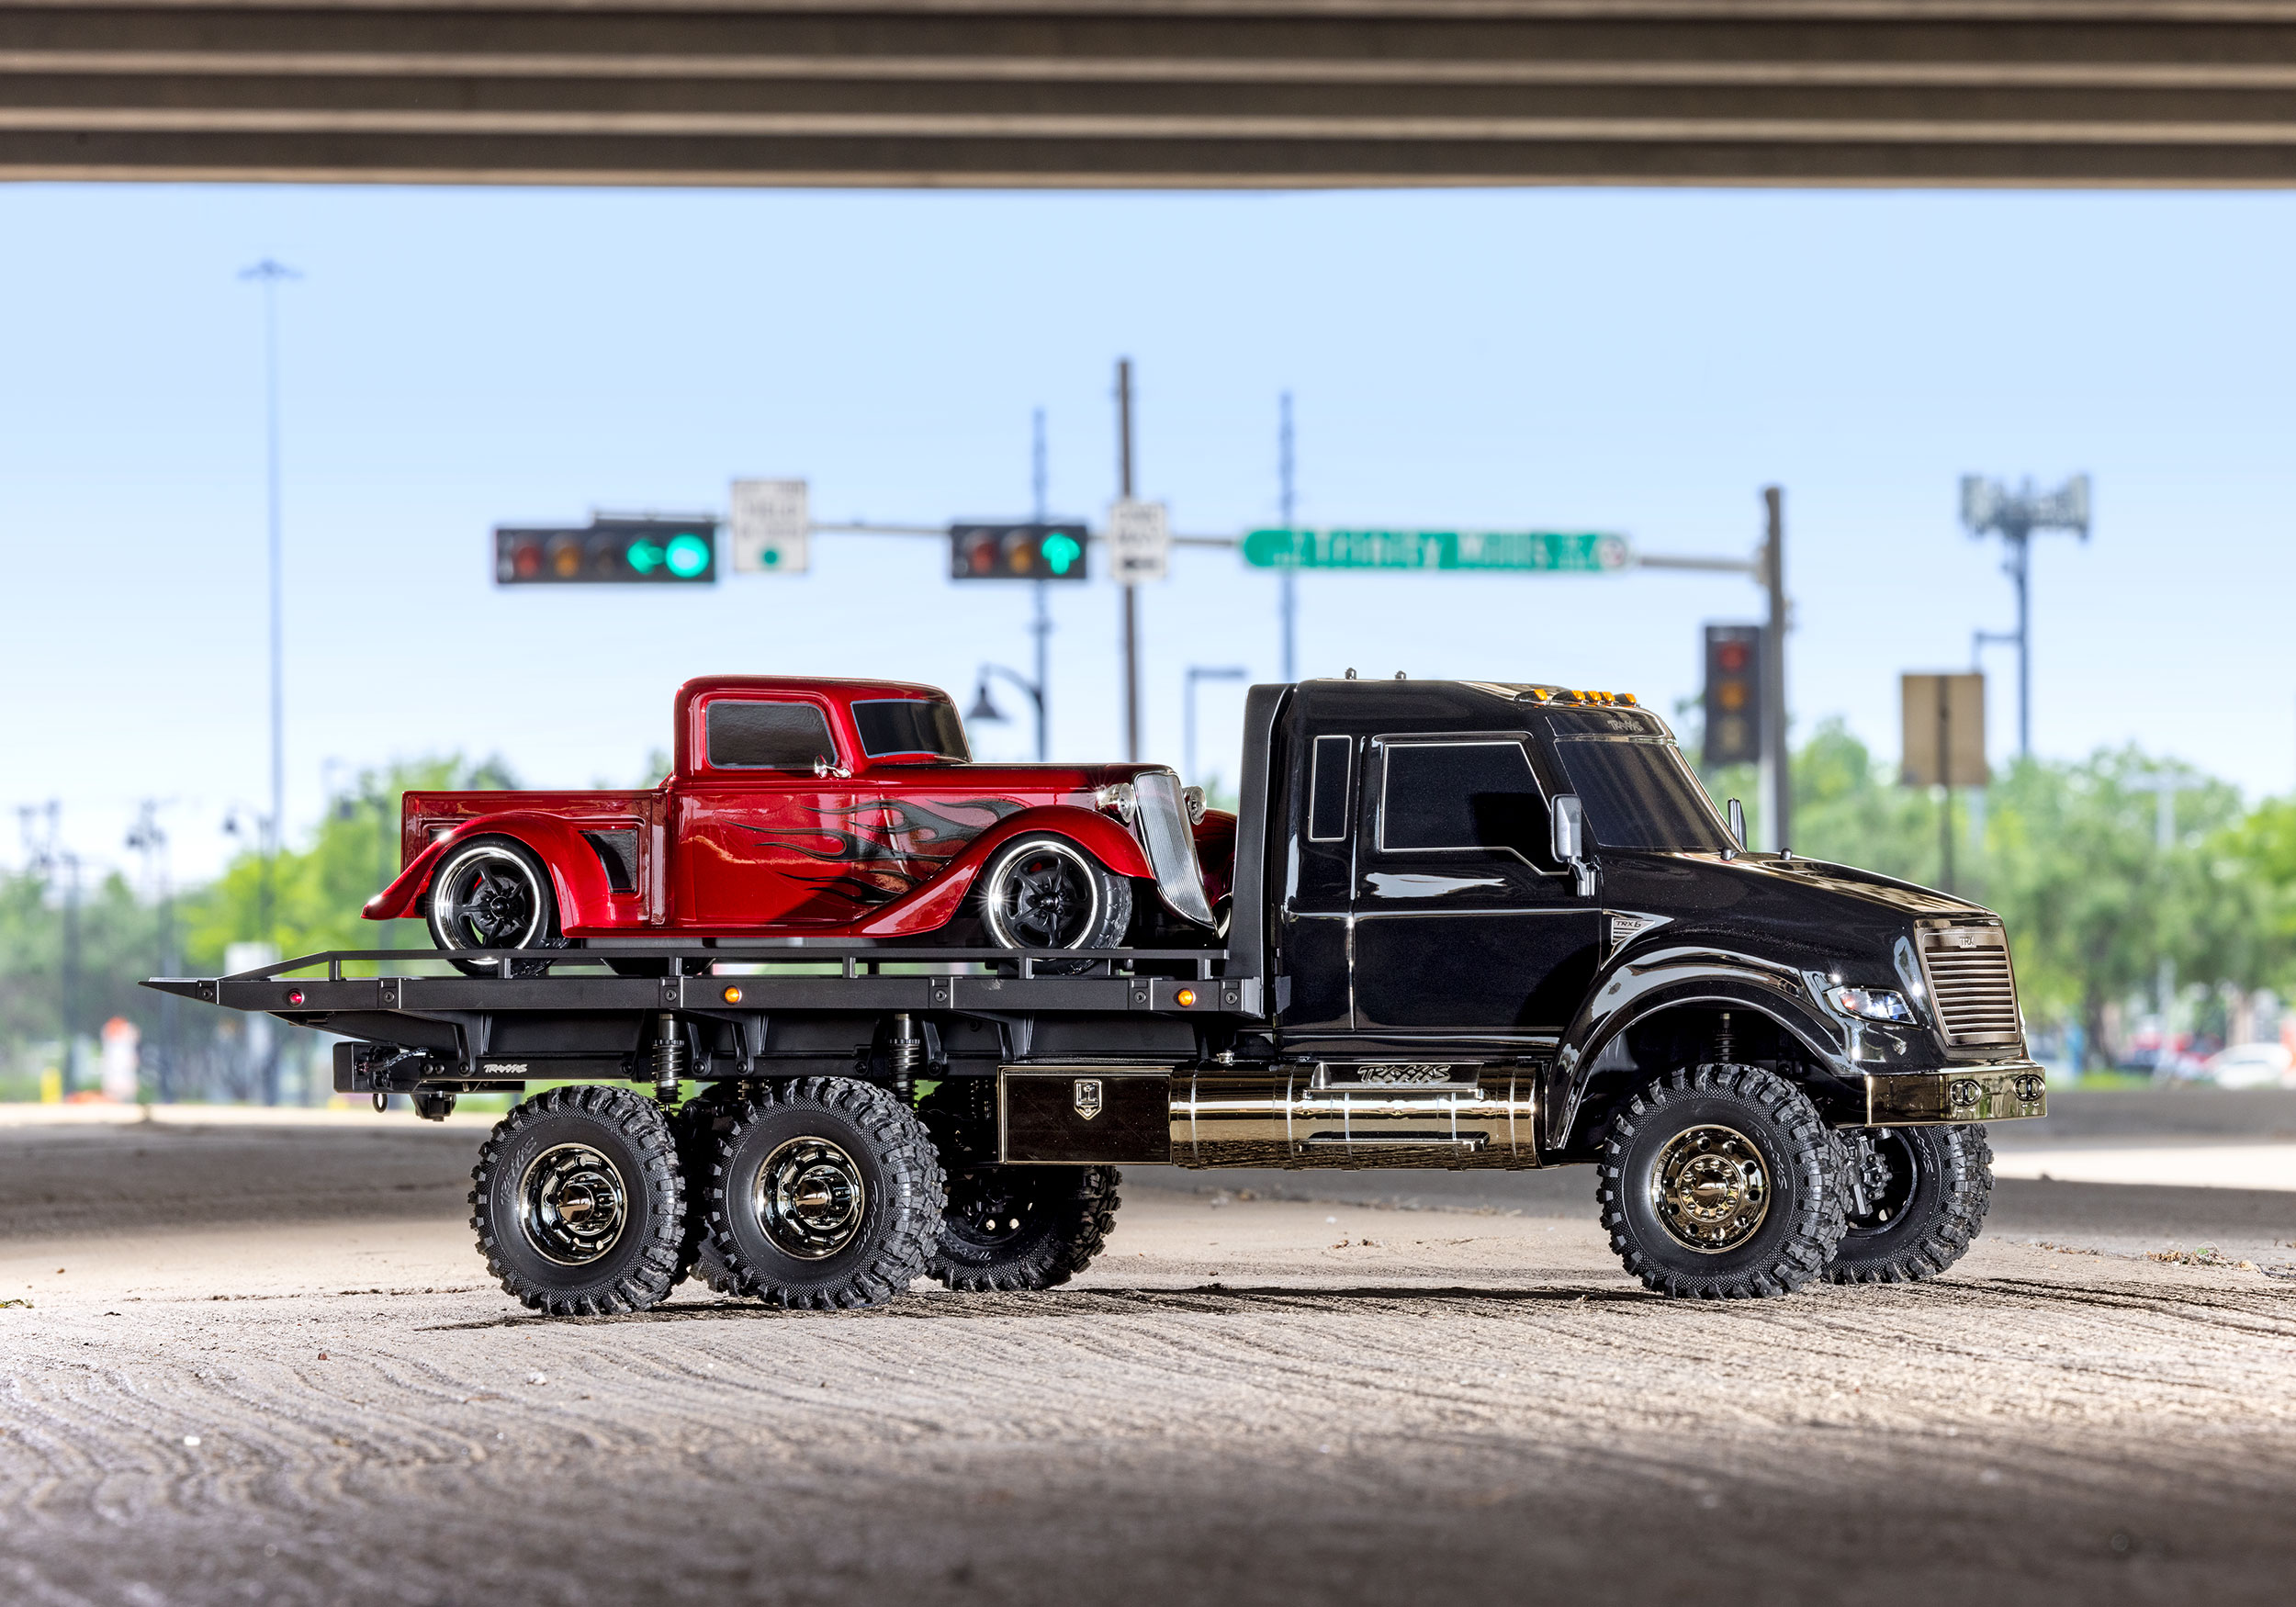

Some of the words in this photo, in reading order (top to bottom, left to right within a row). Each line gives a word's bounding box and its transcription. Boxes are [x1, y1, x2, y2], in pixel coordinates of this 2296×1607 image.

[1607, 719, 1644, 733] TRAXXAS
[483, 1063, 528, 1074] TRAXXAS
[1357, 1064, 1452, 1084] TRAXXAS
